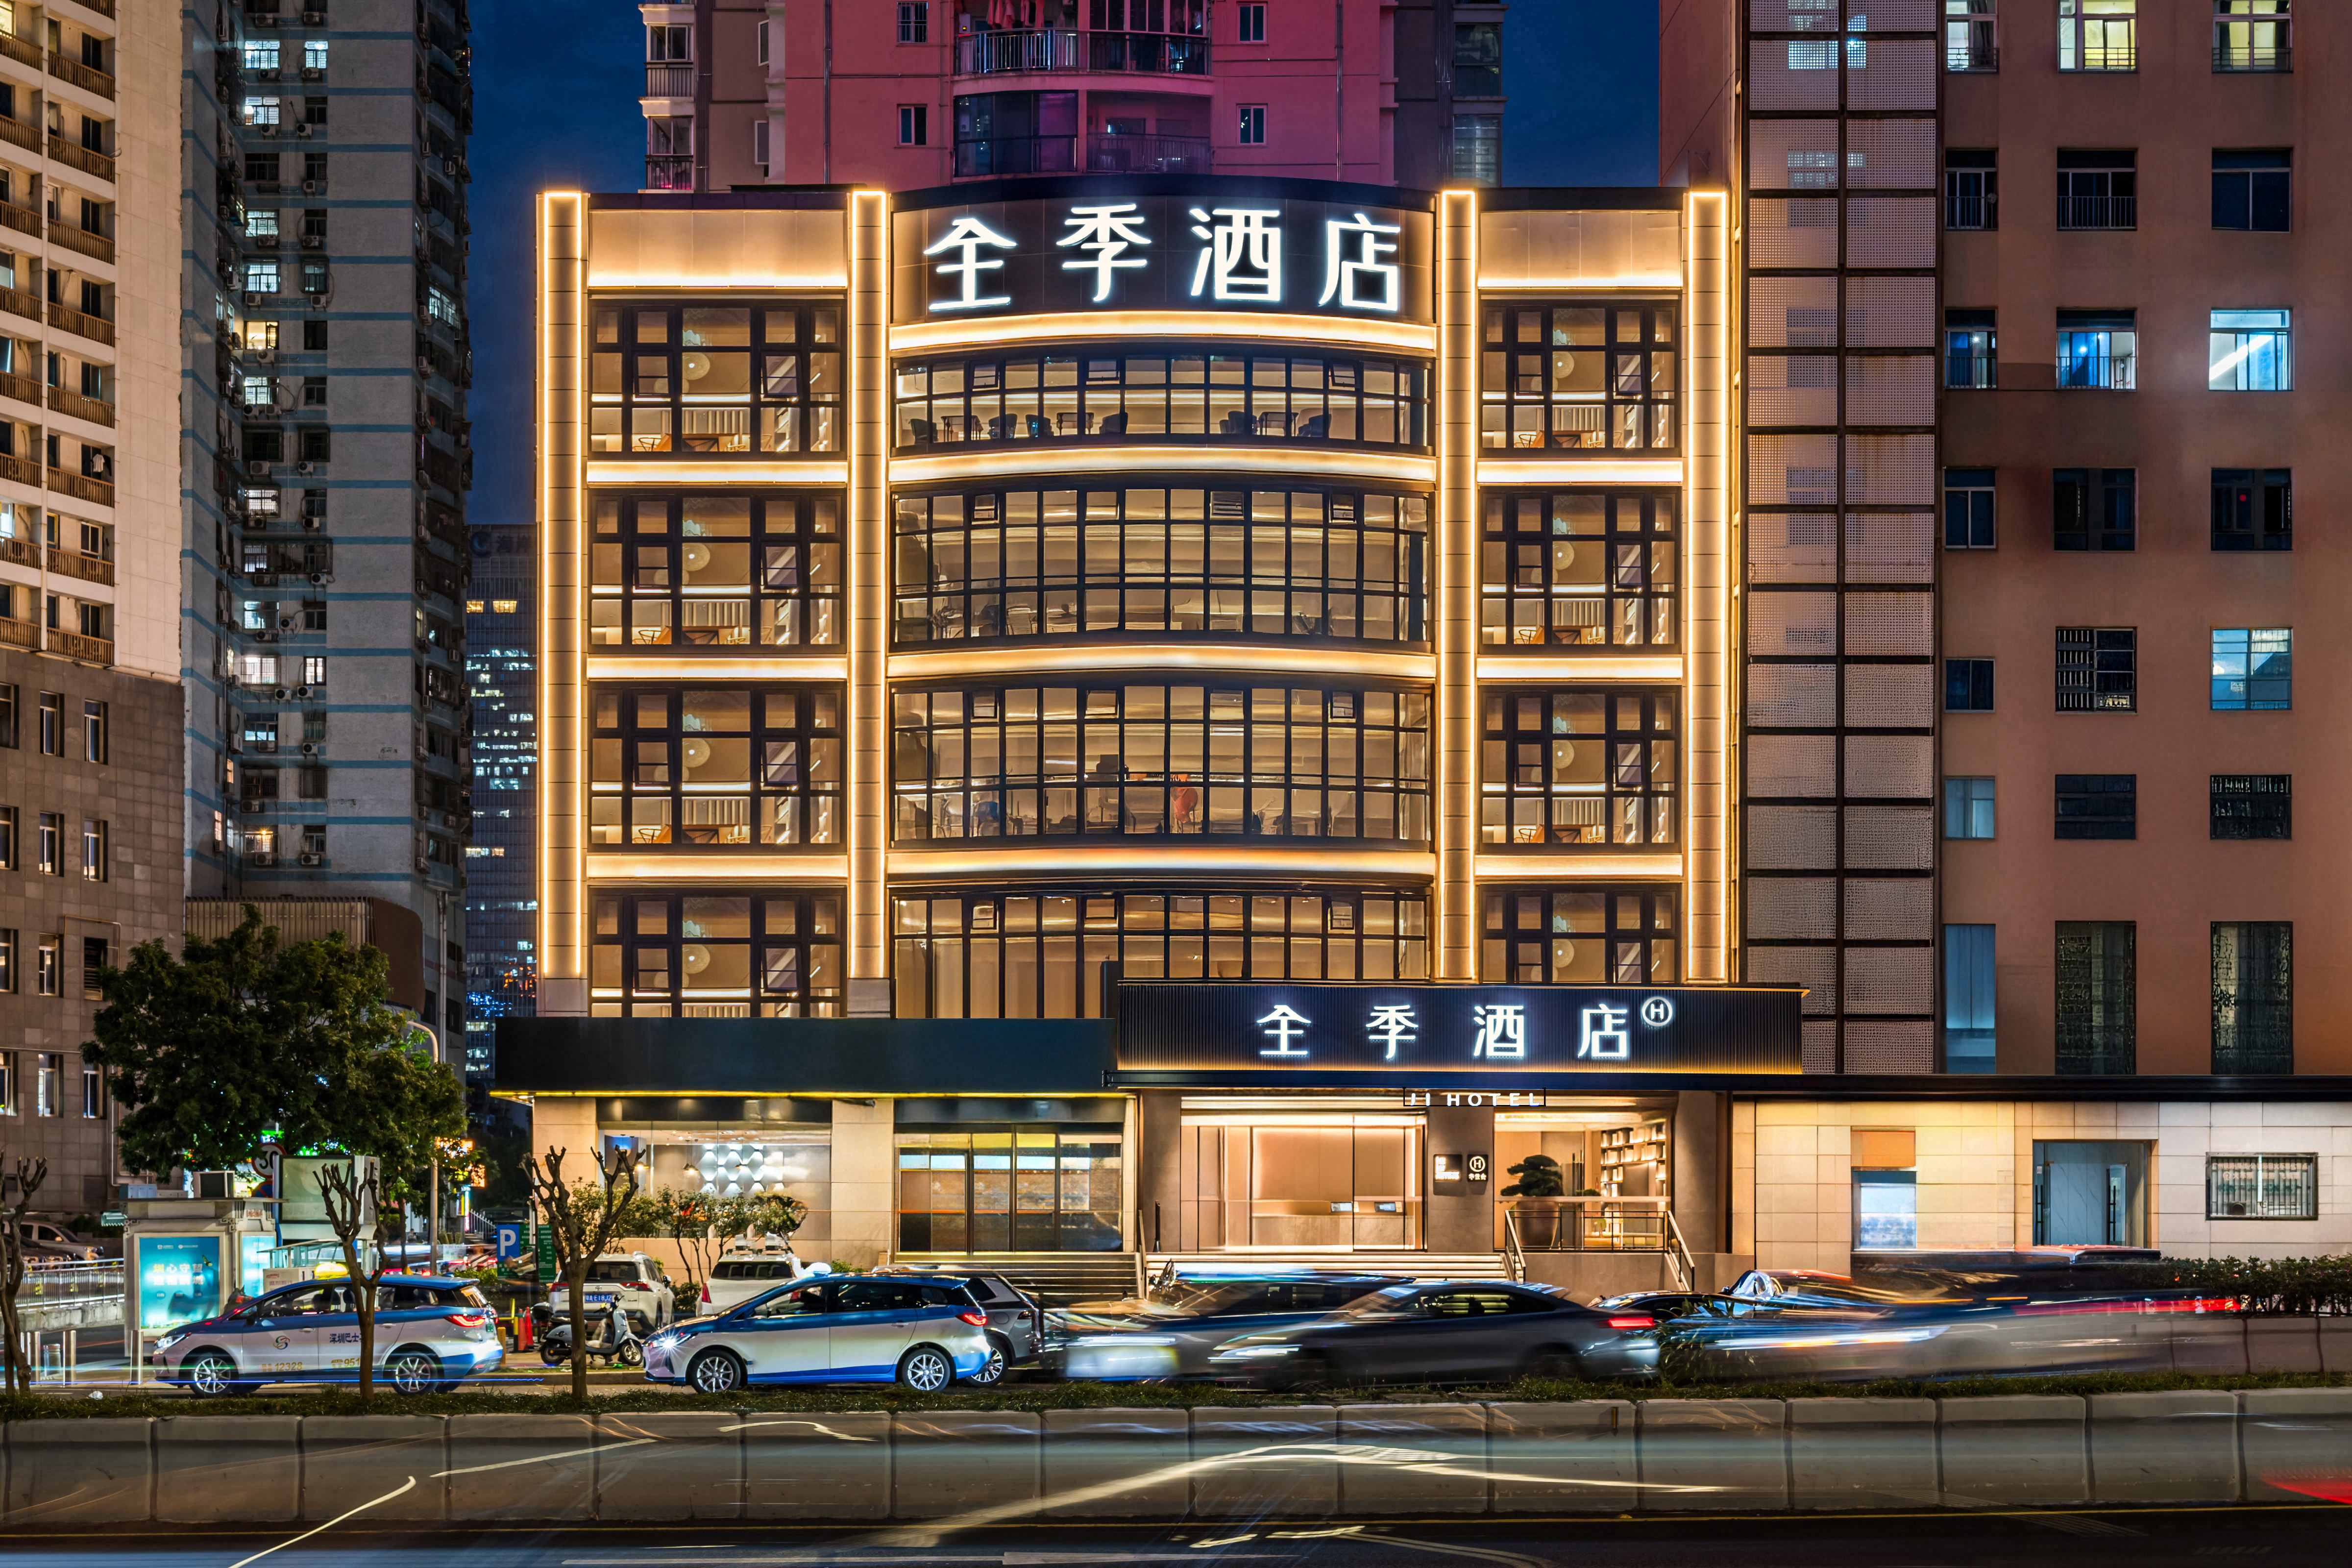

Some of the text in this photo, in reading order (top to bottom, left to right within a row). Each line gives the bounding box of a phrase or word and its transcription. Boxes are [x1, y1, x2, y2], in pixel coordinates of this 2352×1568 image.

[923, 203, 1401, 311] 全季酒店
[1256, 1003, 1628, 1060] 全季酒店
[1410, 1093, 1540, 1106] JI HOTEL
[500, 1229, 516, 1256] P
[329, 1332, 361, 1344] 深圳巴士
[275, 1361, 303, 1372] 12328
